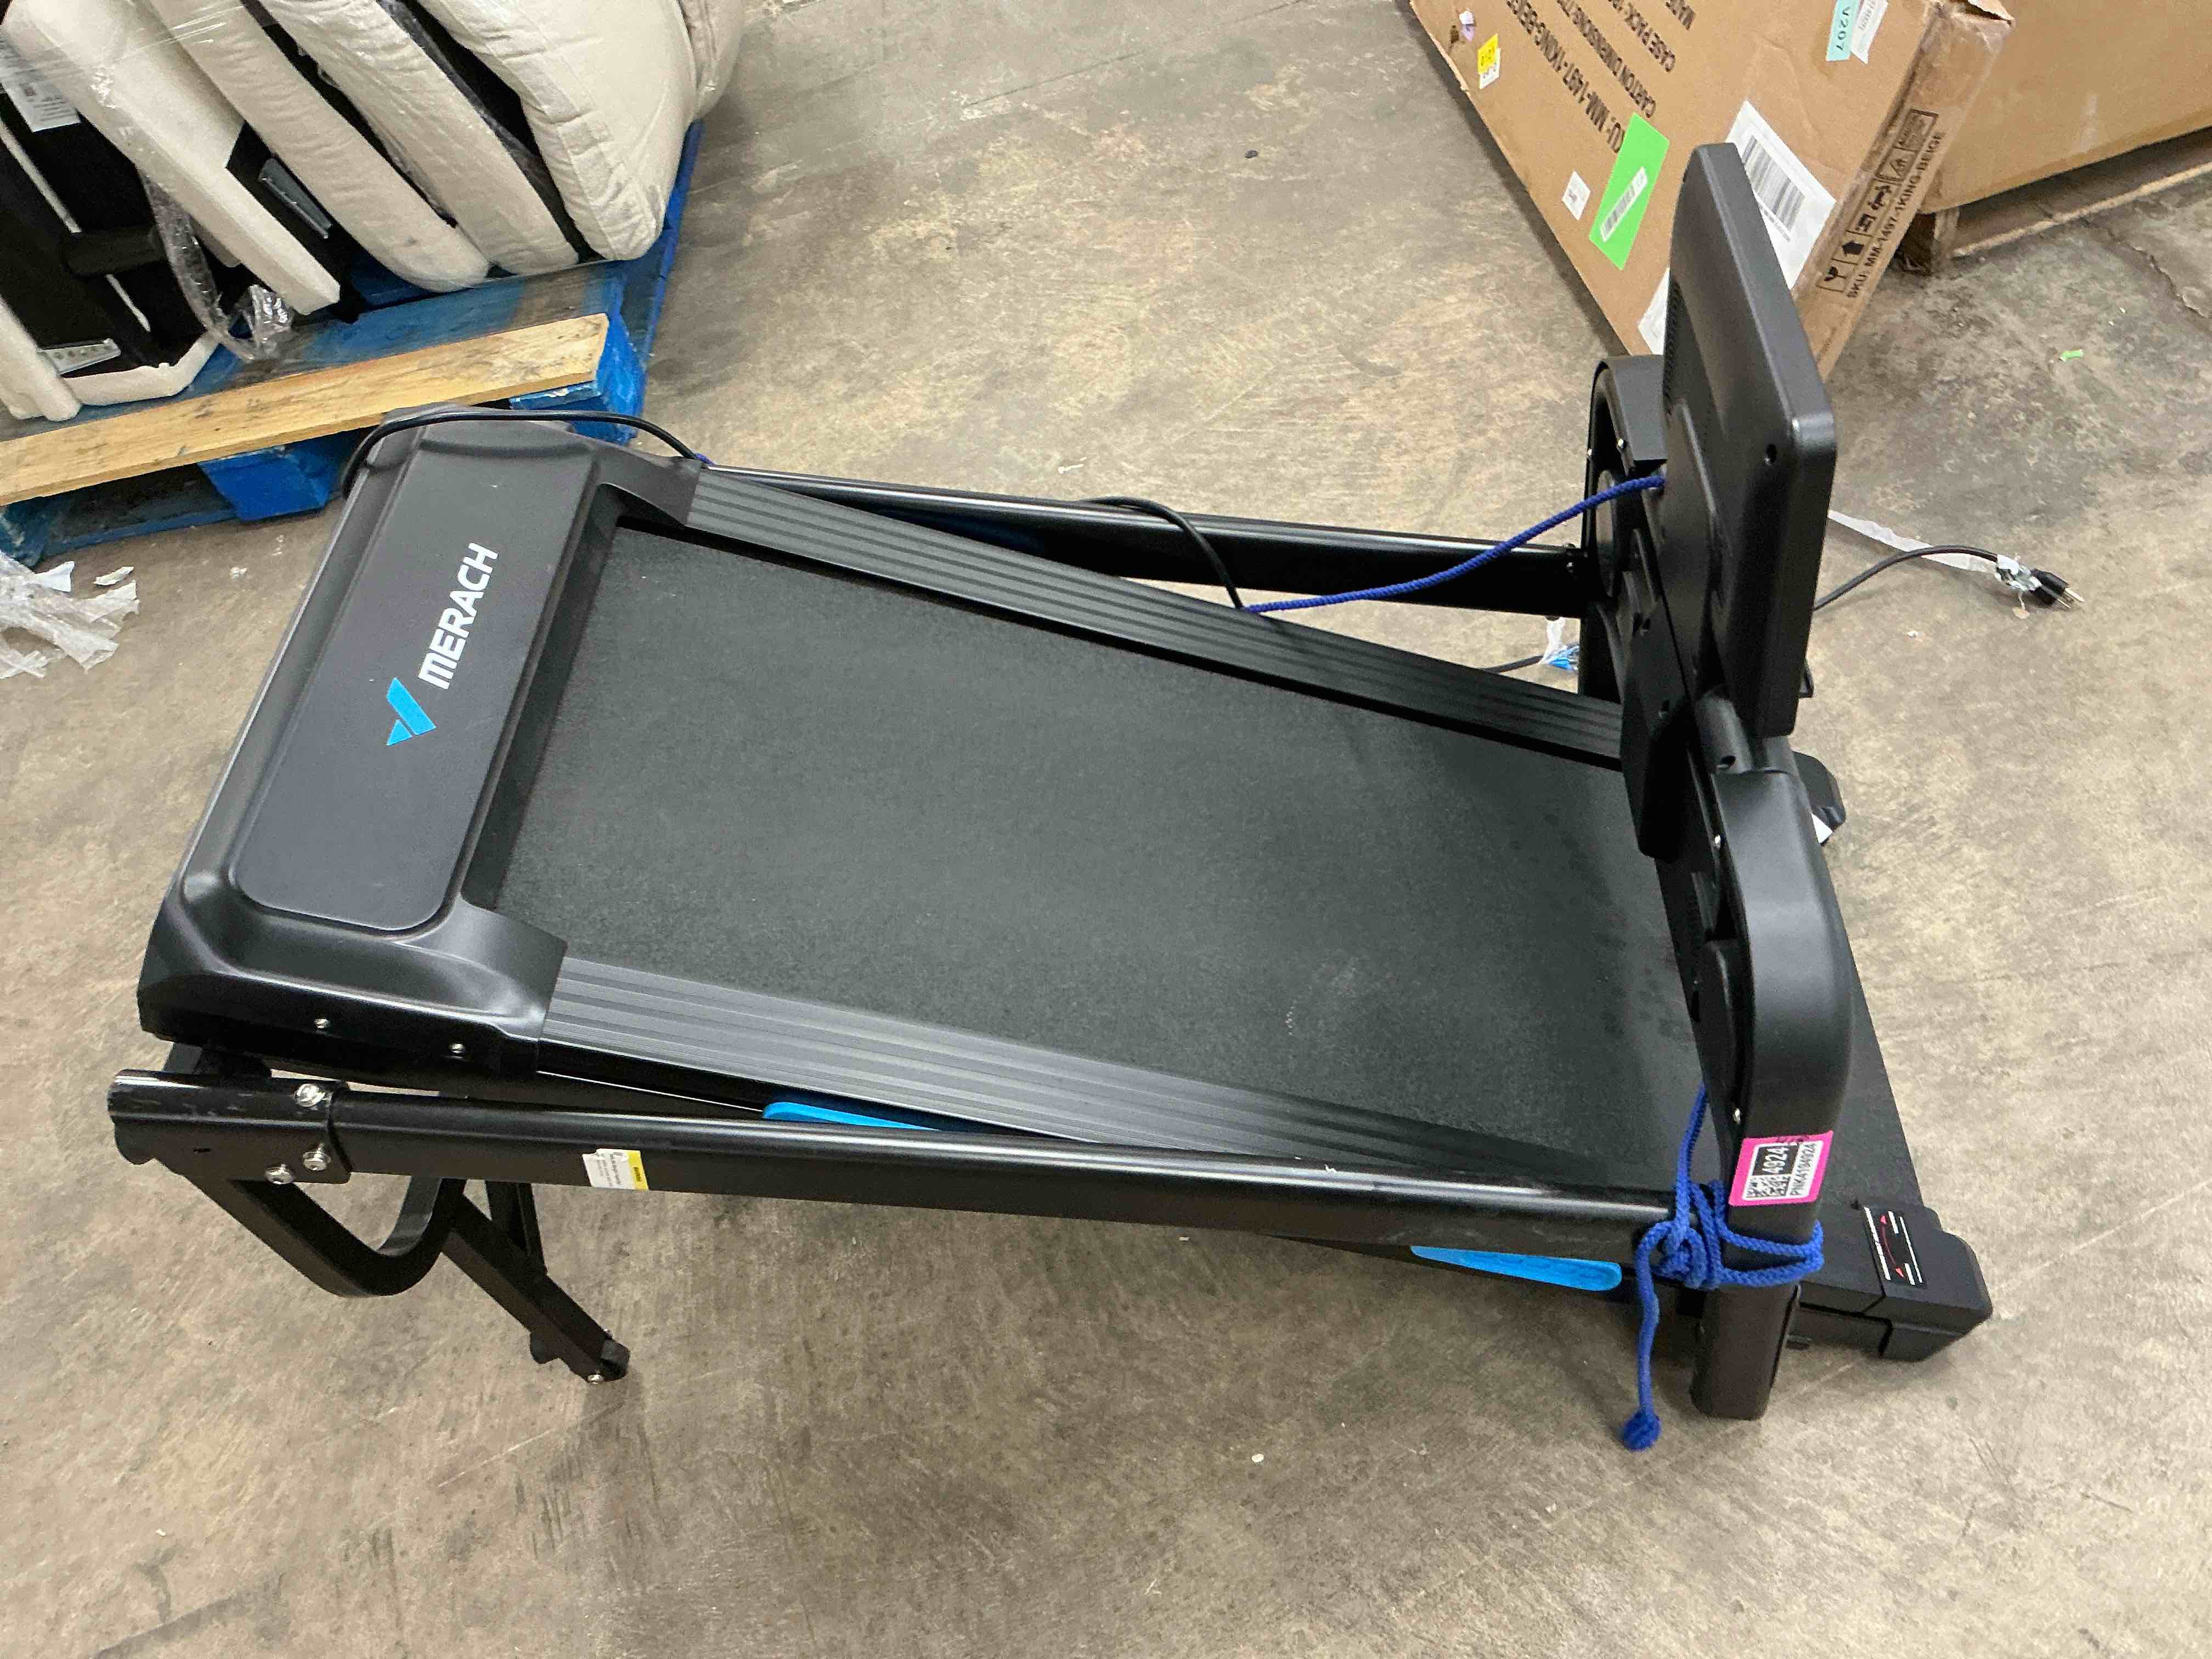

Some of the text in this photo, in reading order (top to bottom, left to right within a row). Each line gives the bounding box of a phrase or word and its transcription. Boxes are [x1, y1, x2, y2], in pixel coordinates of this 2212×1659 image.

[1648, 32, 1676, 72] CASE
[1619, 65, 1656, 119] CARTON
[417, 542, 499, 690] MERACH
[1762, 1146, 1790, 1175] 4924
